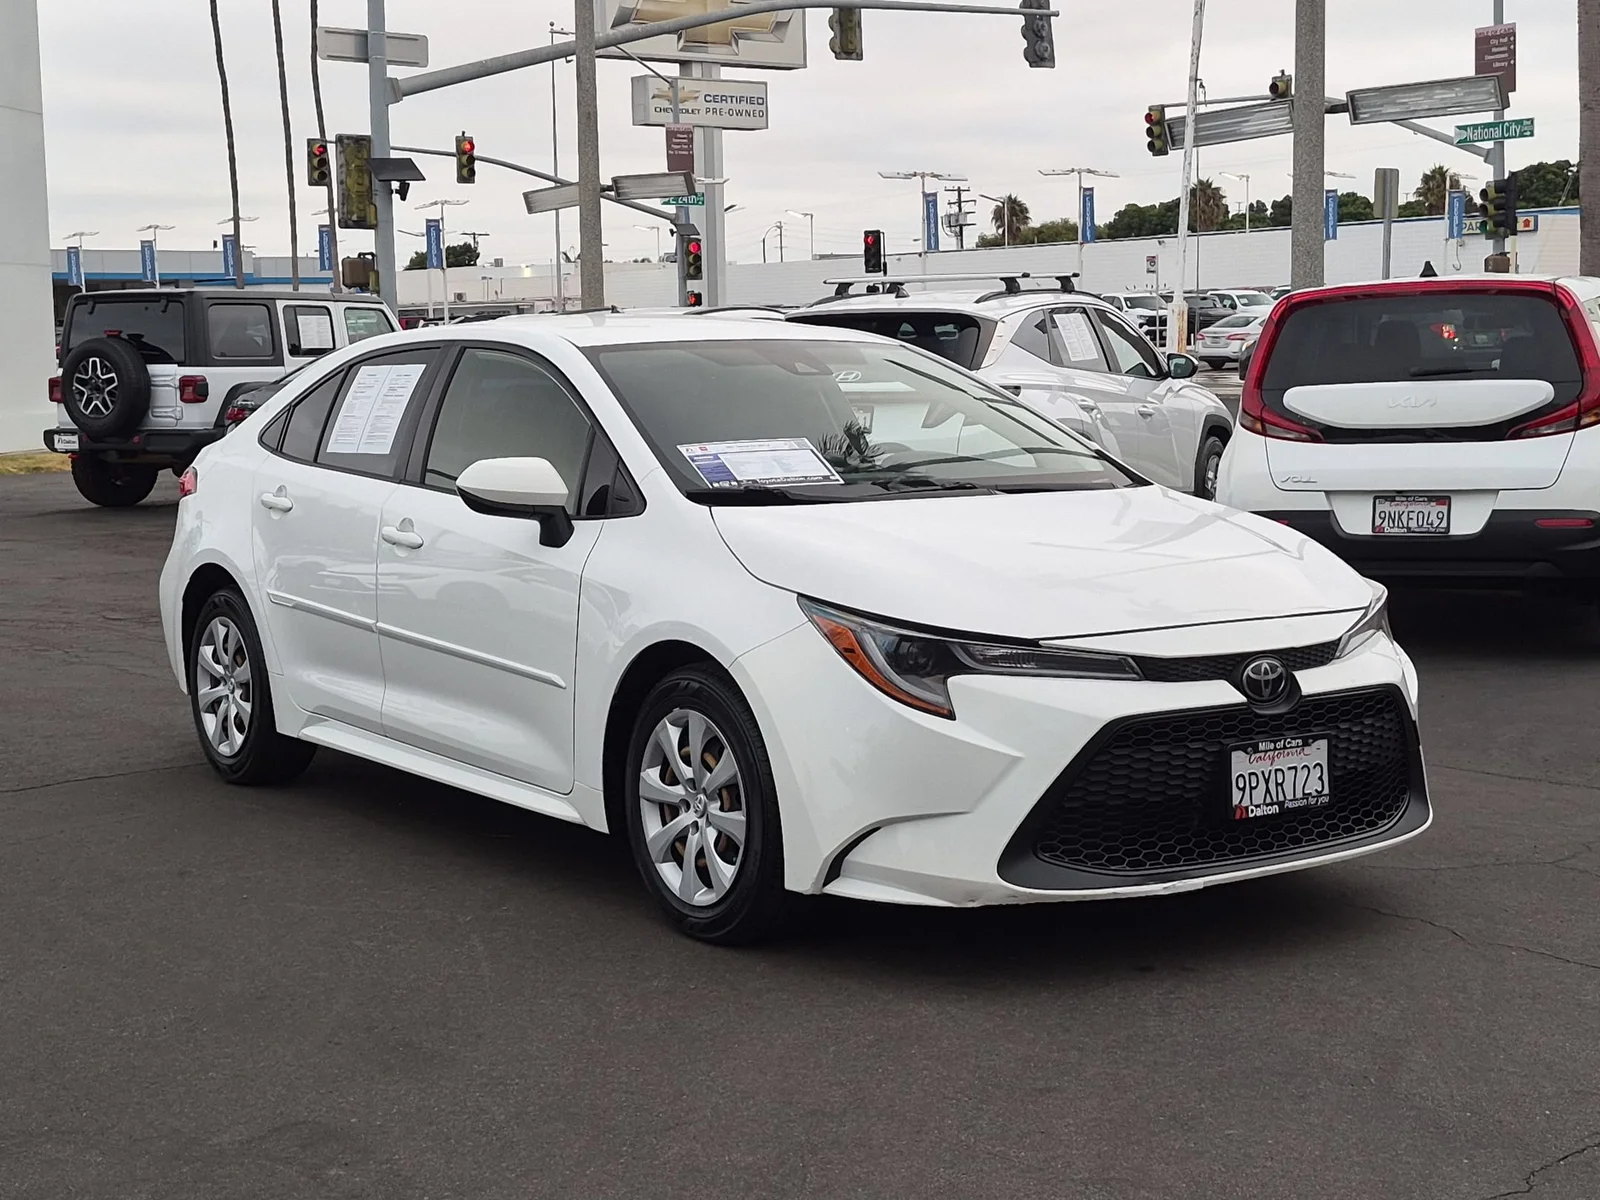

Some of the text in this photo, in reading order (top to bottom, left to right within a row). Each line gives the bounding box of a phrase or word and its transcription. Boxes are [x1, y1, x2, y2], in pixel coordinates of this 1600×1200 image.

[703, 93, 765, 106] CERTIFIED
[705, 107, 765, 118] PRE-OWNED
[1467, 121, 1521, 141] National City
[1463, 222, 1481, 232] PAR
[1258, 738, 1303, 752] Mile of Cars
[1248, 747, 1312, 766] California
[1235, 762, 1325, 806] 9PXR723
[1284, 795, 1330, 809] Passion for you
[1248, 804, 1280, 818] Dalton
